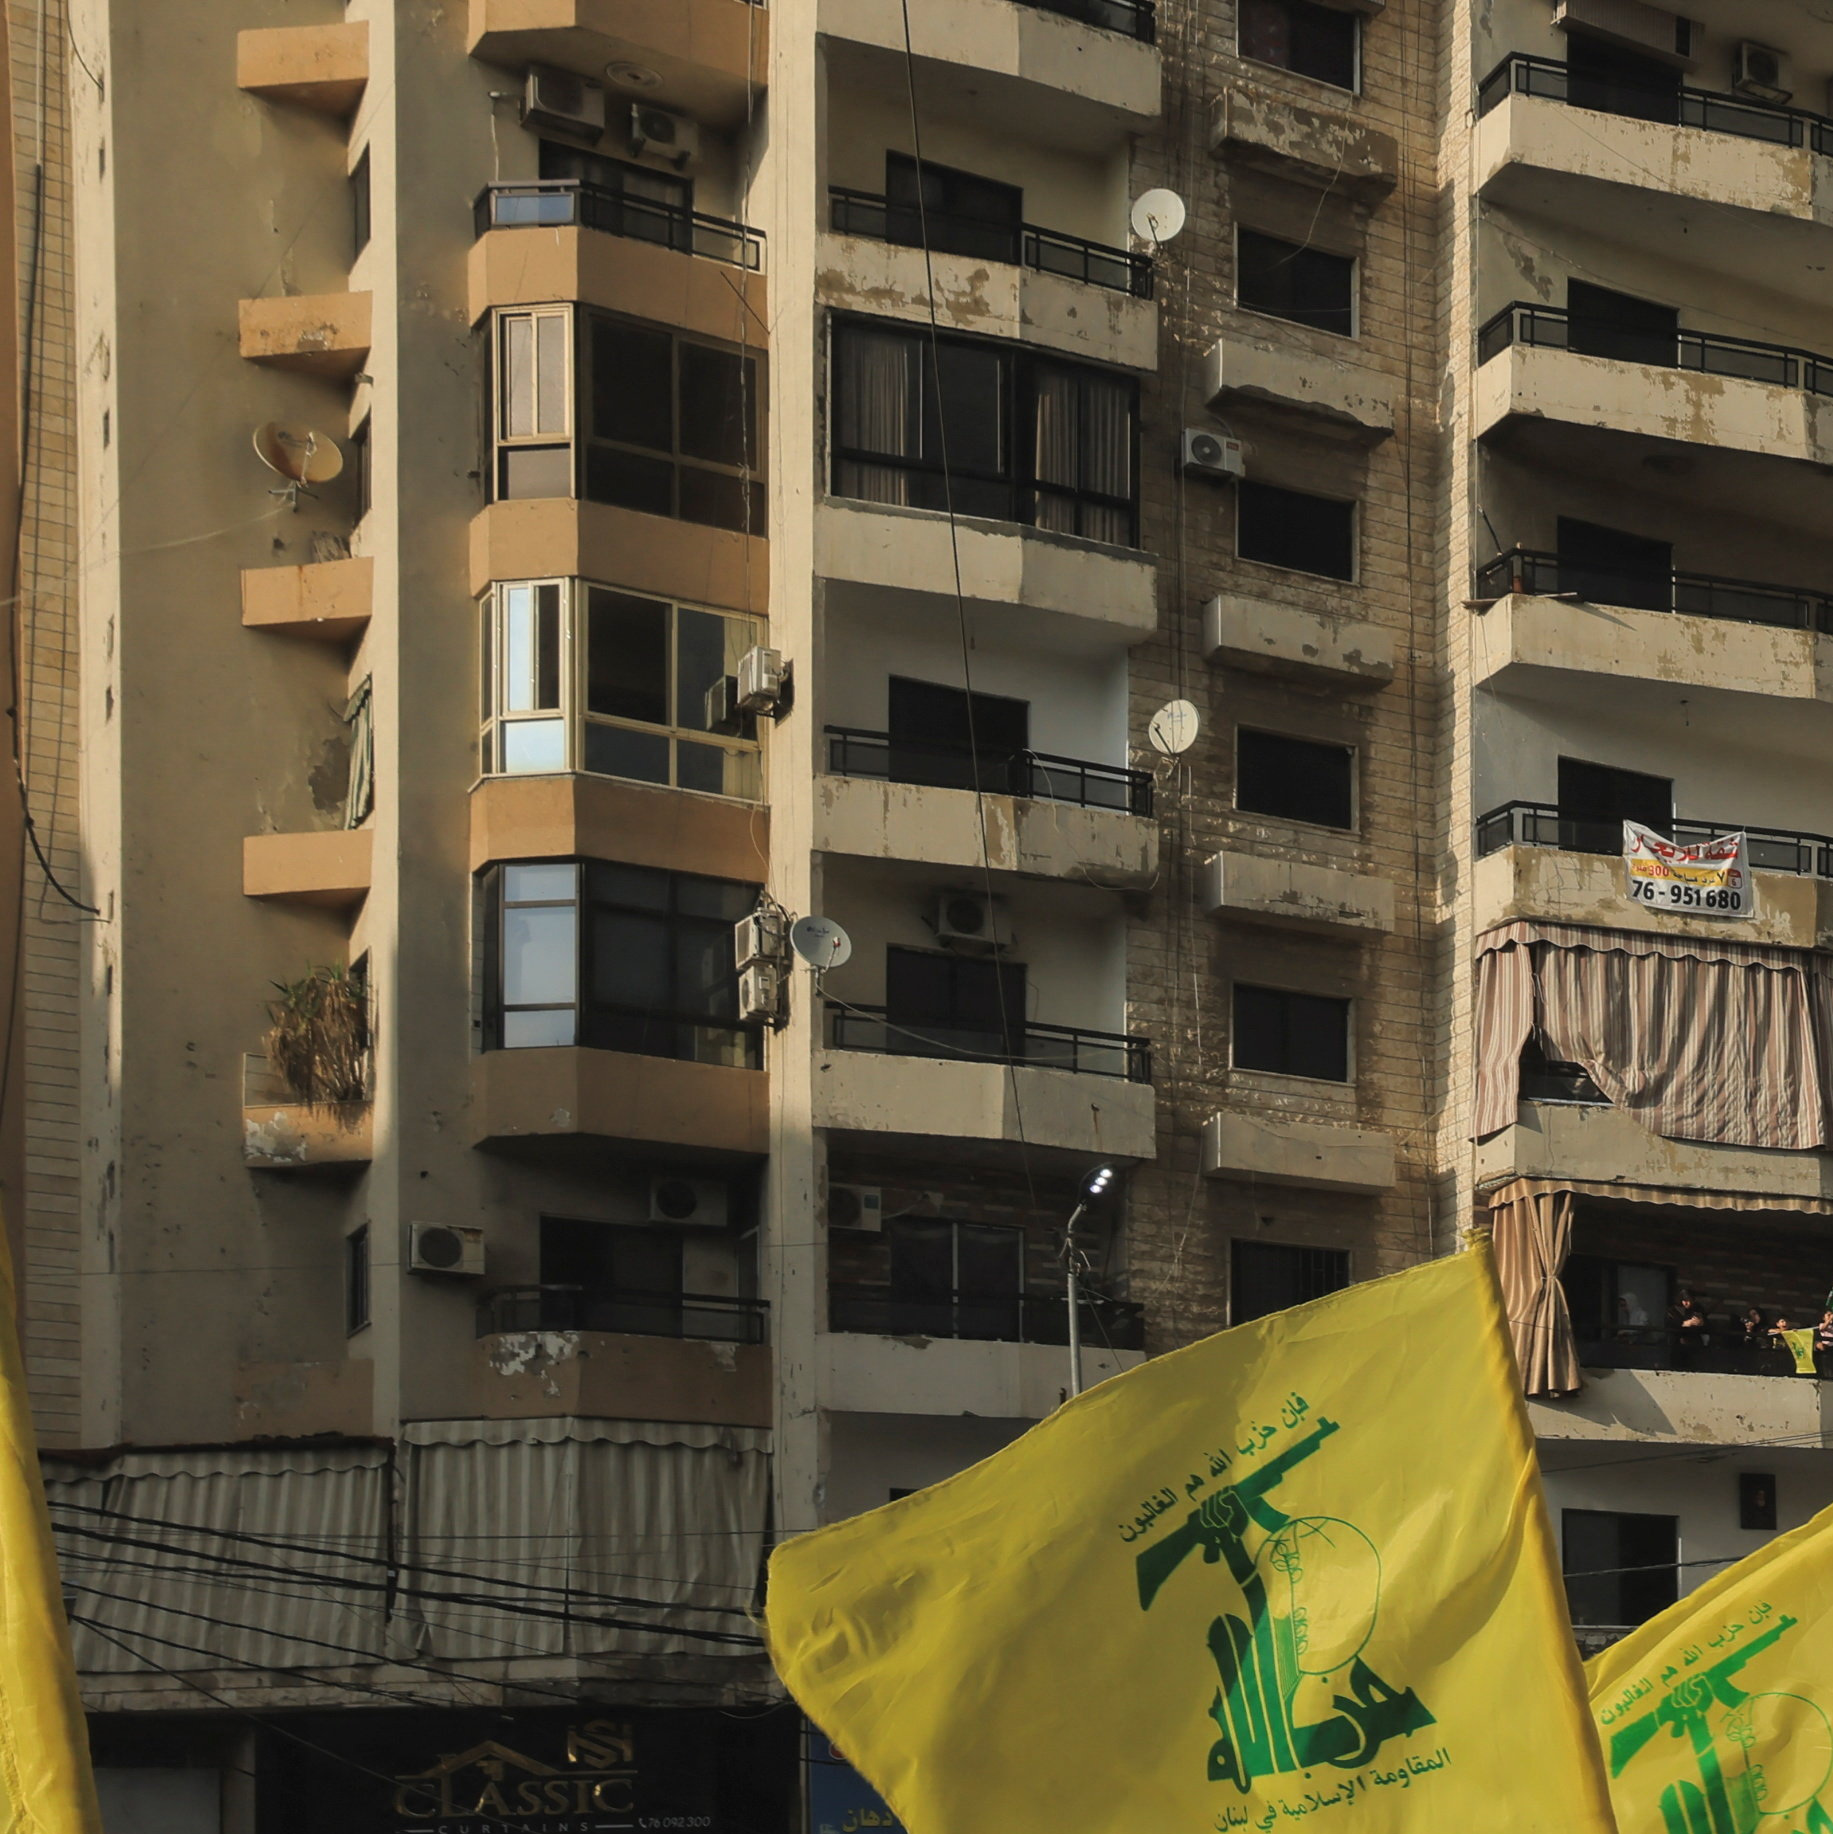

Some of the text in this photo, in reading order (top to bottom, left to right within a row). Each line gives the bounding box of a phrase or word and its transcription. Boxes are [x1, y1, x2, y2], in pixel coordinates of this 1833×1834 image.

[1700, 838, 1739, 860] شقة
[1632, 880, 1655, 901] 76
[1670, 885, 1701, 907] 951
[1706, 889, 1741, 911] 680
[1118, 1391, 1310, 1543] فإن حزب الله هم الغالبون
[1708, 1623, 1745, 1649] حزب
[1680, 1645, 1704, 1667] الله
[1660, 1665, 1679, 1689] هم
[1600, 1677, 1655, 1725] الغالبون
[393, 1773, 635, 1819] CLASSIC
[1213, 1747, 1452, 1834] المقاومة الإسلامية في لبنان
